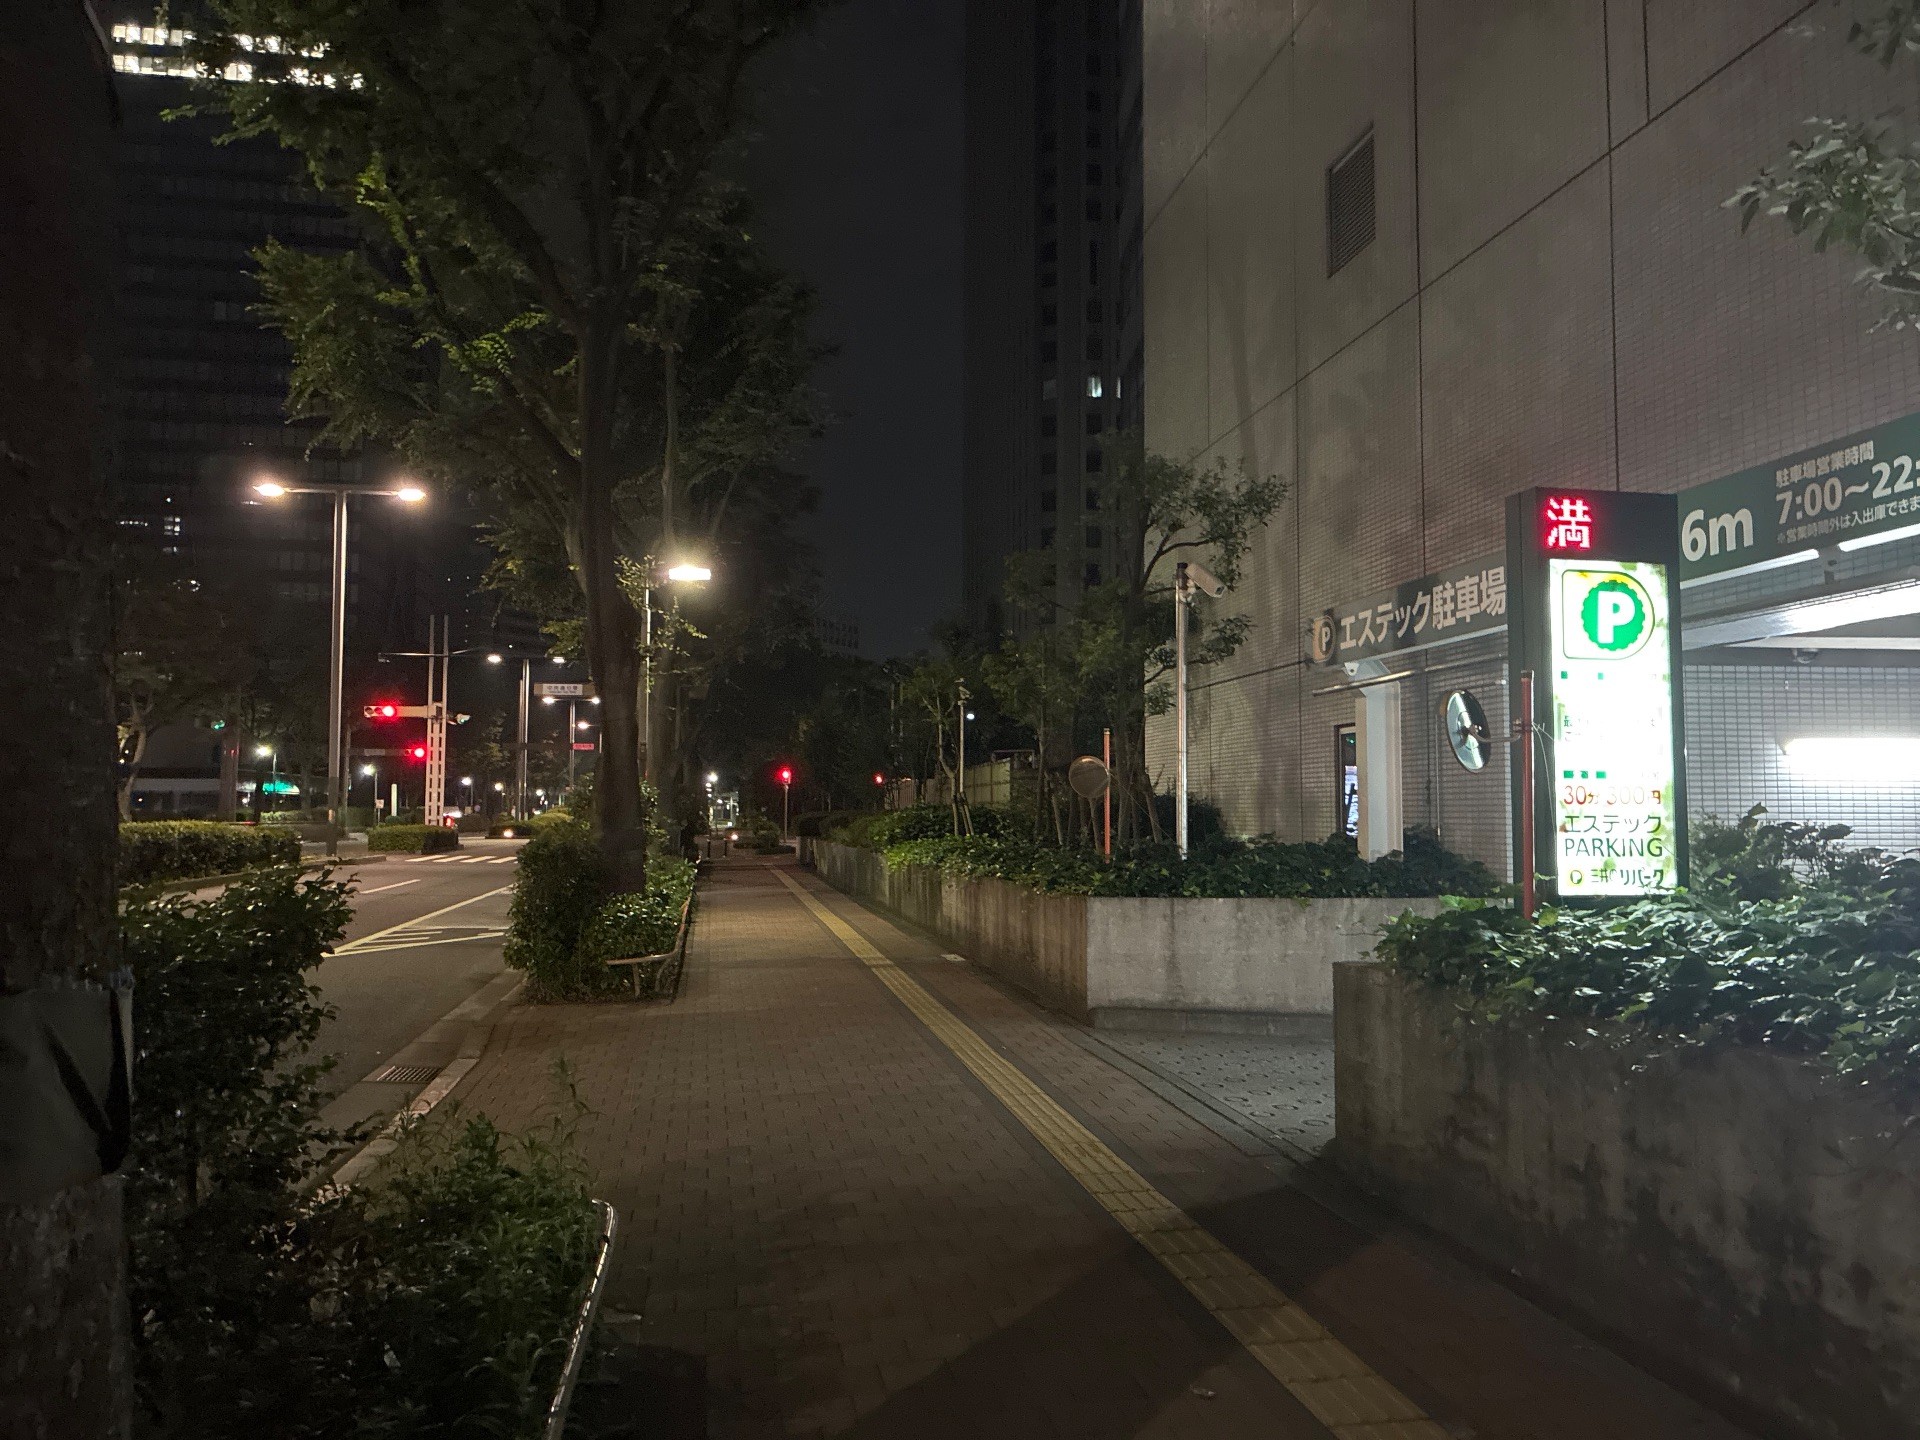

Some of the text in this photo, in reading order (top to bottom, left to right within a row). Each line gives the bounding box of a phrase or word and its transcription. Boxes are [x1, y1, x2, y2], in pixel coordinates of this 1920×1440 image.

[1545, 497, 1593, 550] 満
[1681, 507, 1755, 562] 6m
[1339, 566, 1507, 650] エステック駐車場
[1597, 591, 1635, 644] P
[1564, 814, 1662, 834] エステック
[1564, 837, 1663, 858] PARKING
